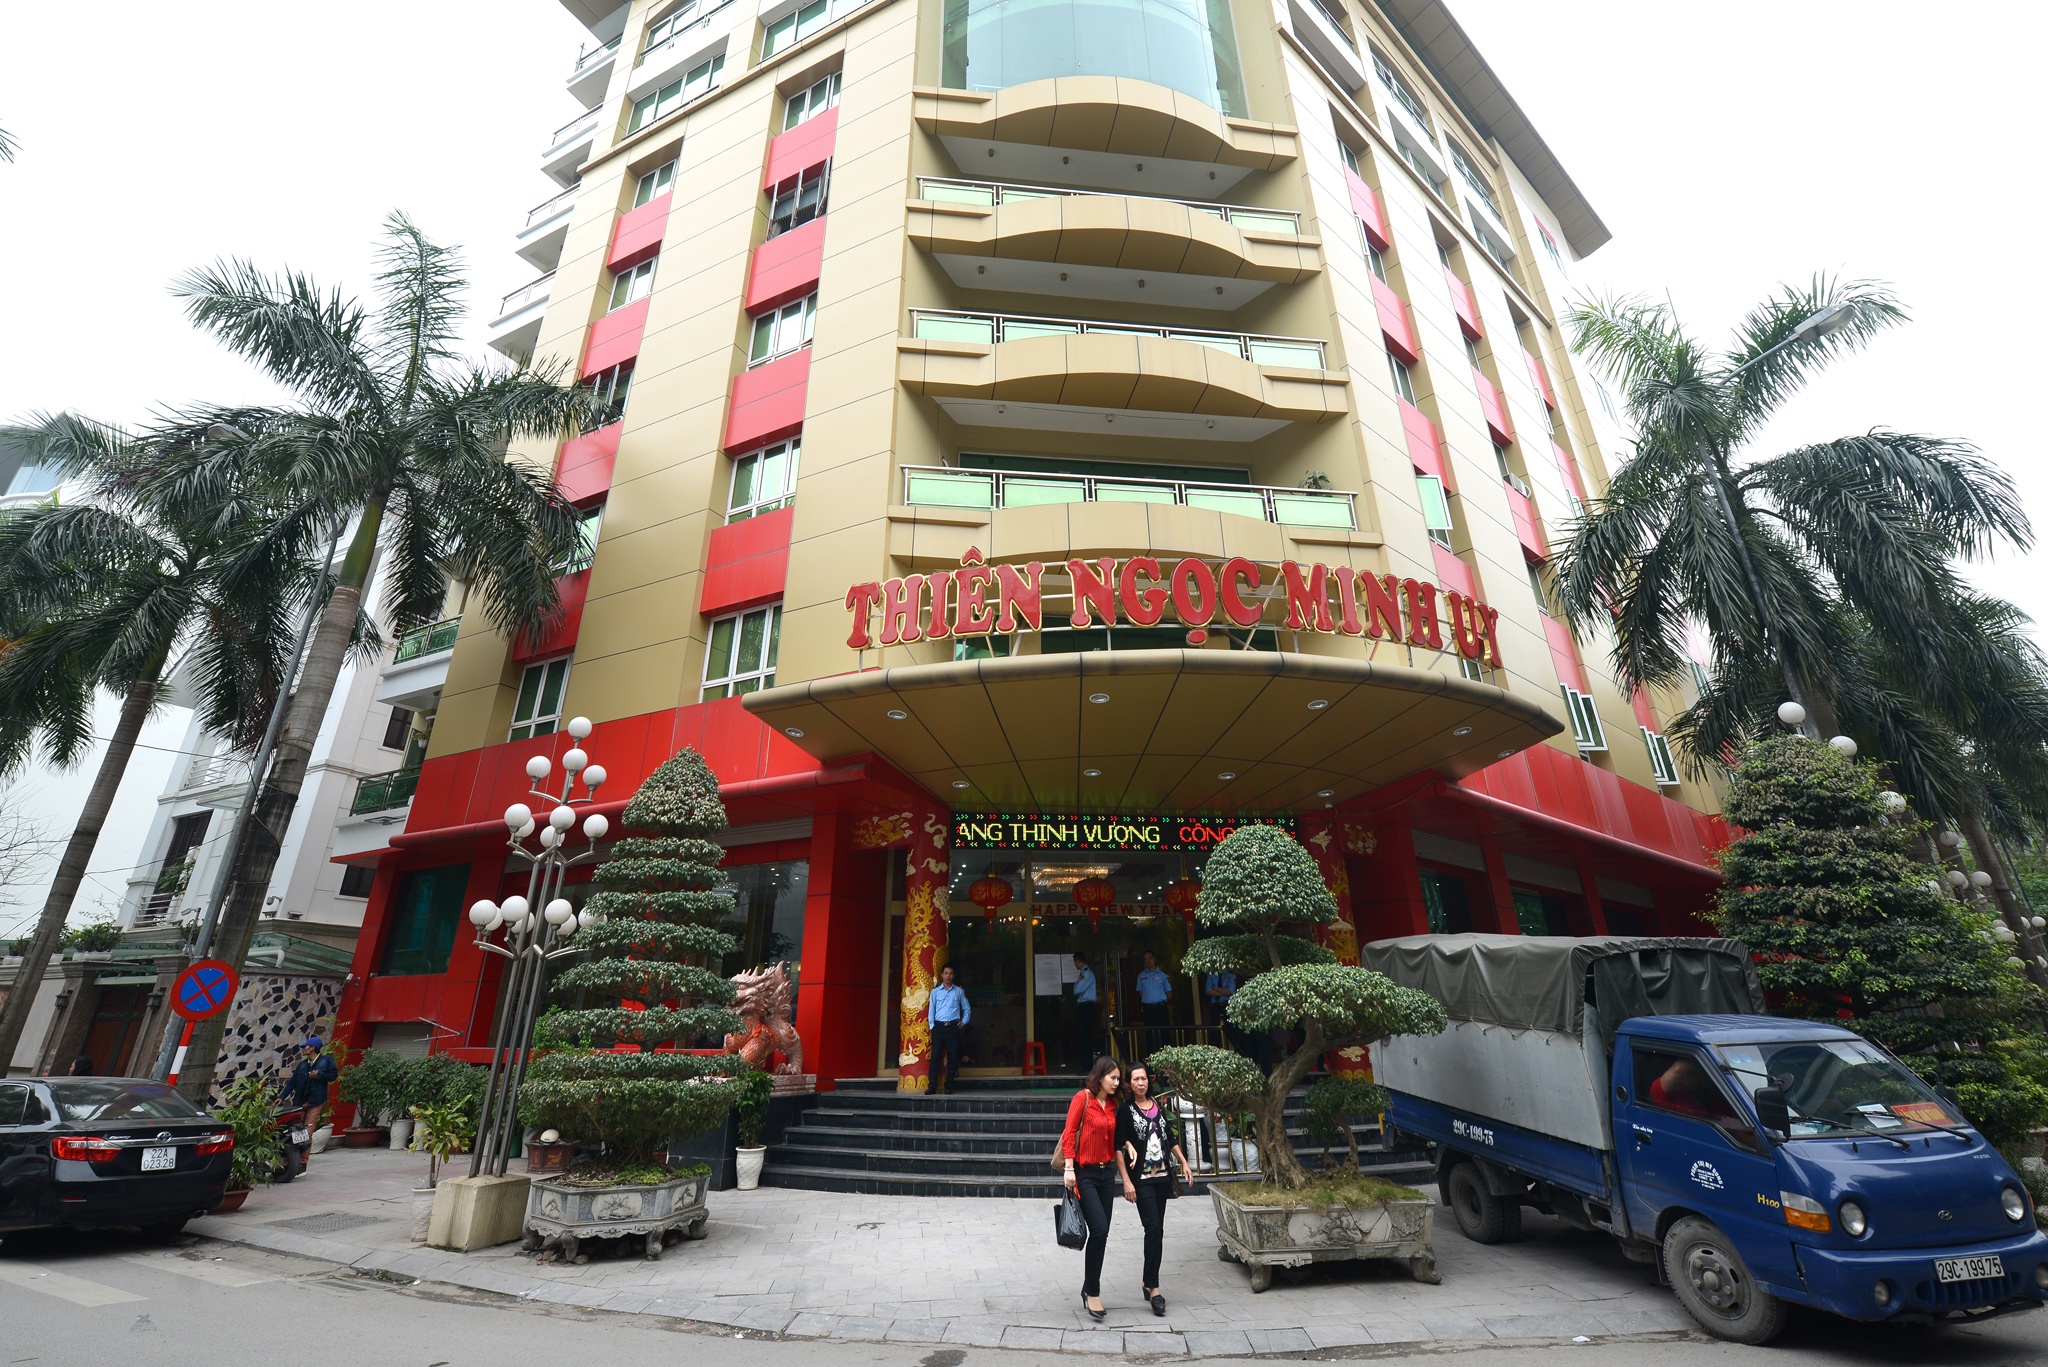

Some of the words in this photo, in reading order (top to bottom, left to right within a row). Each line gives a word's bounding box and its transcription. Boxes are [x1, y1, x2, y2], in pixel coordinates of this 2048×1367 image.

[845, 545, 1045, 651] THIÊN
[1067, 557, 1264, 646] NGỌC
[1280, 559, 1443, 650] MINH
[1445, 590, 1503, 670] UY
[1009, 823, 1078, 844] THỊNH
[1083, 821, 1160, 845] VƯỢNG
[1179, 822, 1235, 843] CÔNG
[1031, 904, 1087, 915] HAPPY
[152, 1148, 168, 1159] 22A
[143, 1158, 174, 1169] 023.28
[1757, 1193, 1780, 1208] H100
